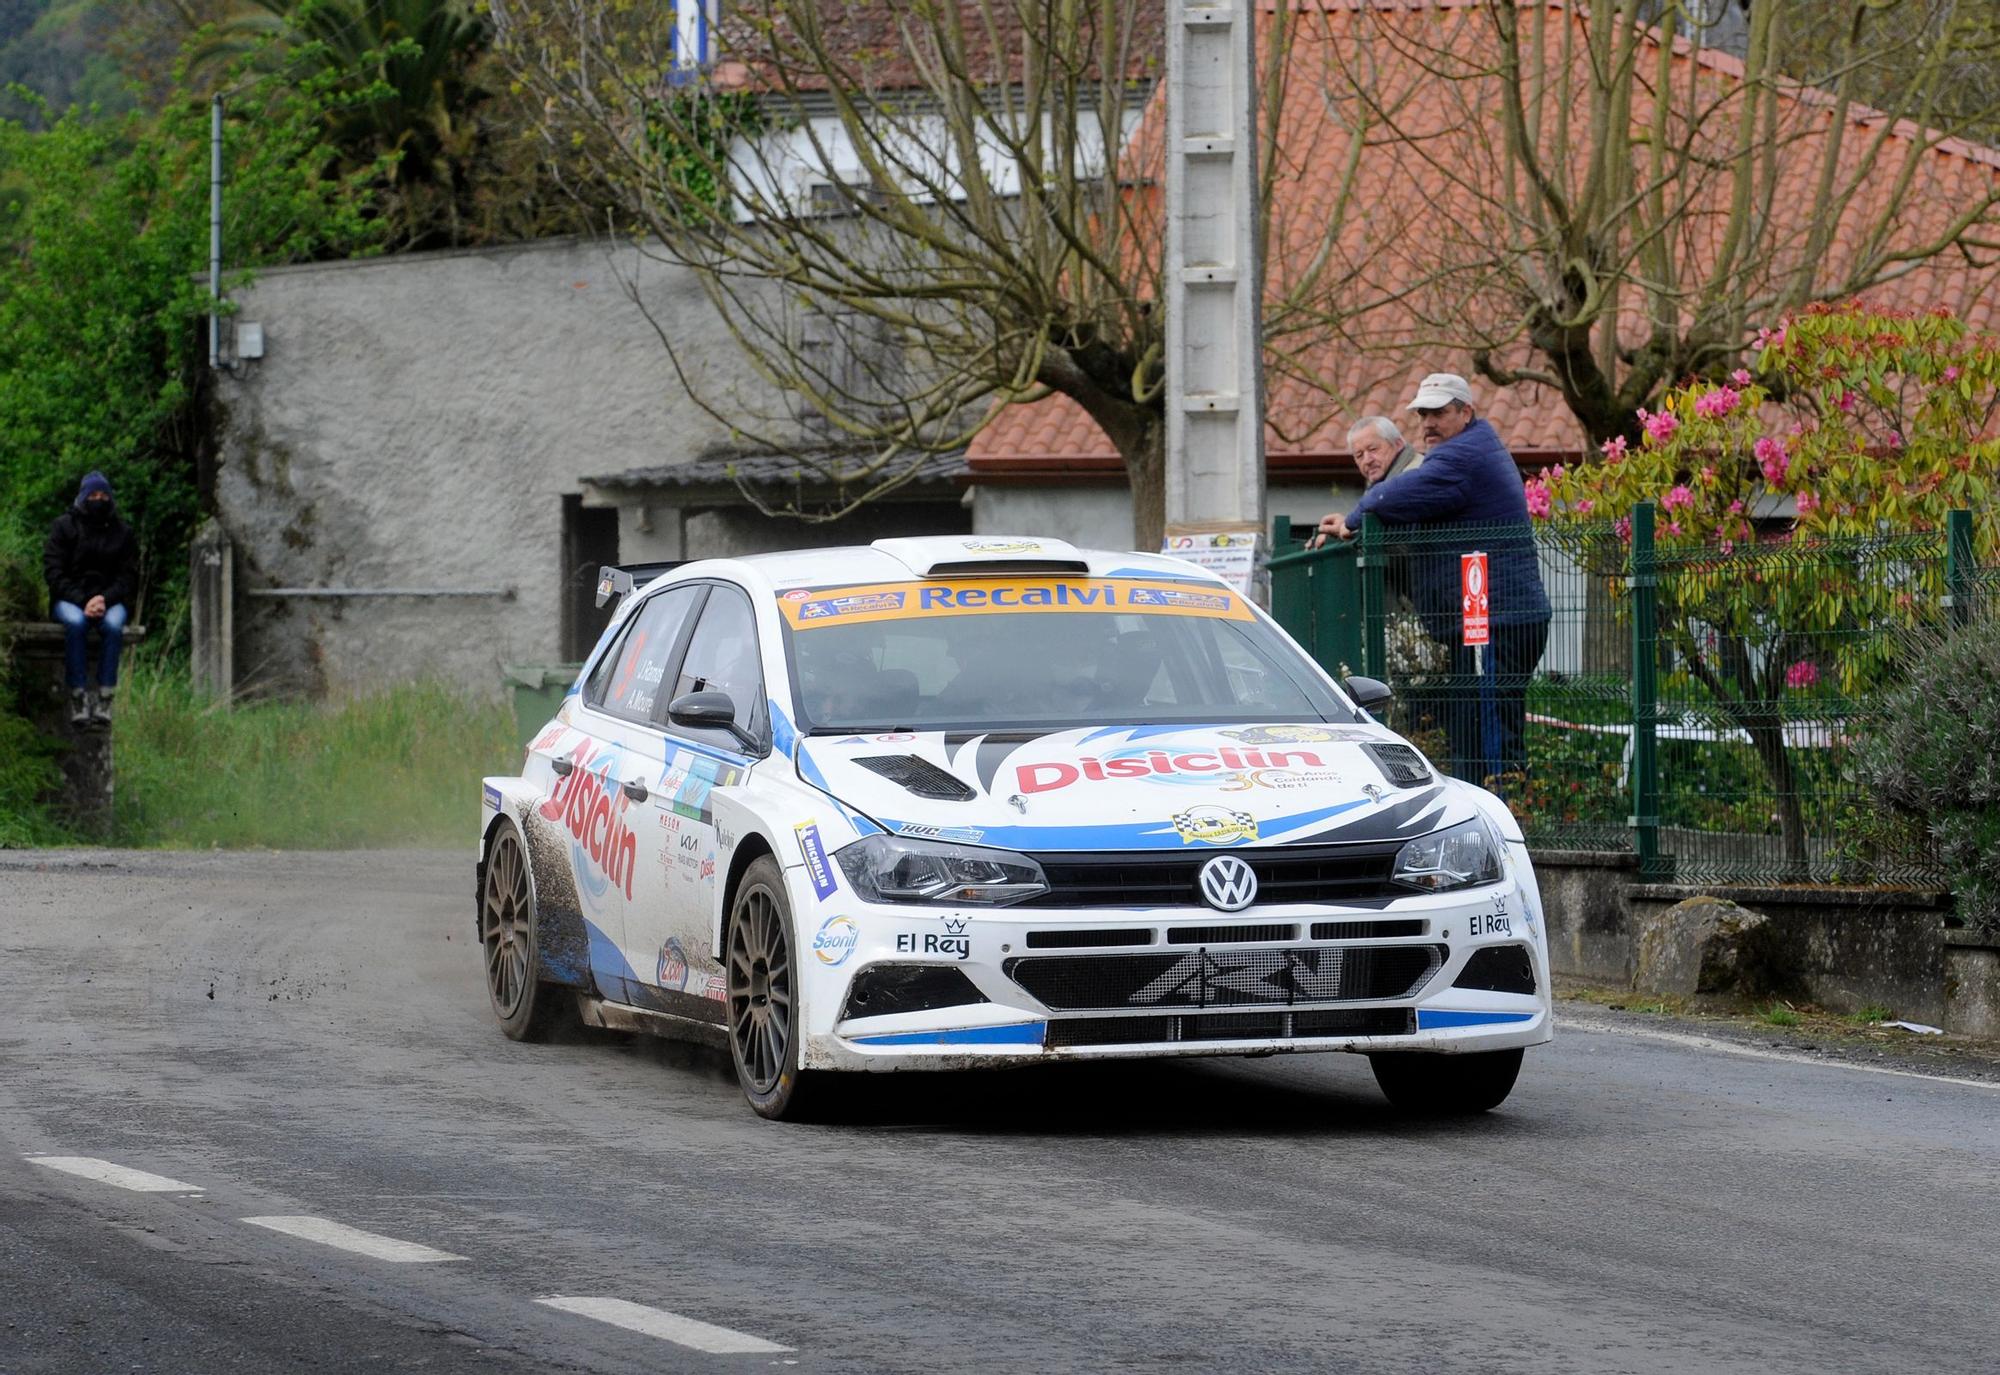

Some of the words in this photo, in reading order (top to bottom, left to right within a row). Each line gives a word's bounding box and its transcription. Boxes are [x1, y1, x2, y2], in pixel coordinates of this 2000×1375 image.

[919, 584, 1116, 609] Recalvi
[1016, 747, 1326, 794] Disiclin
[805, 837, 829, 888] MICHELIN
[1470, 915, 1482, 936] El
[1486, 914, 1512, 937] Rey
[896, 933, 916, 953] El
[924, 934, 970, 960] Rey
